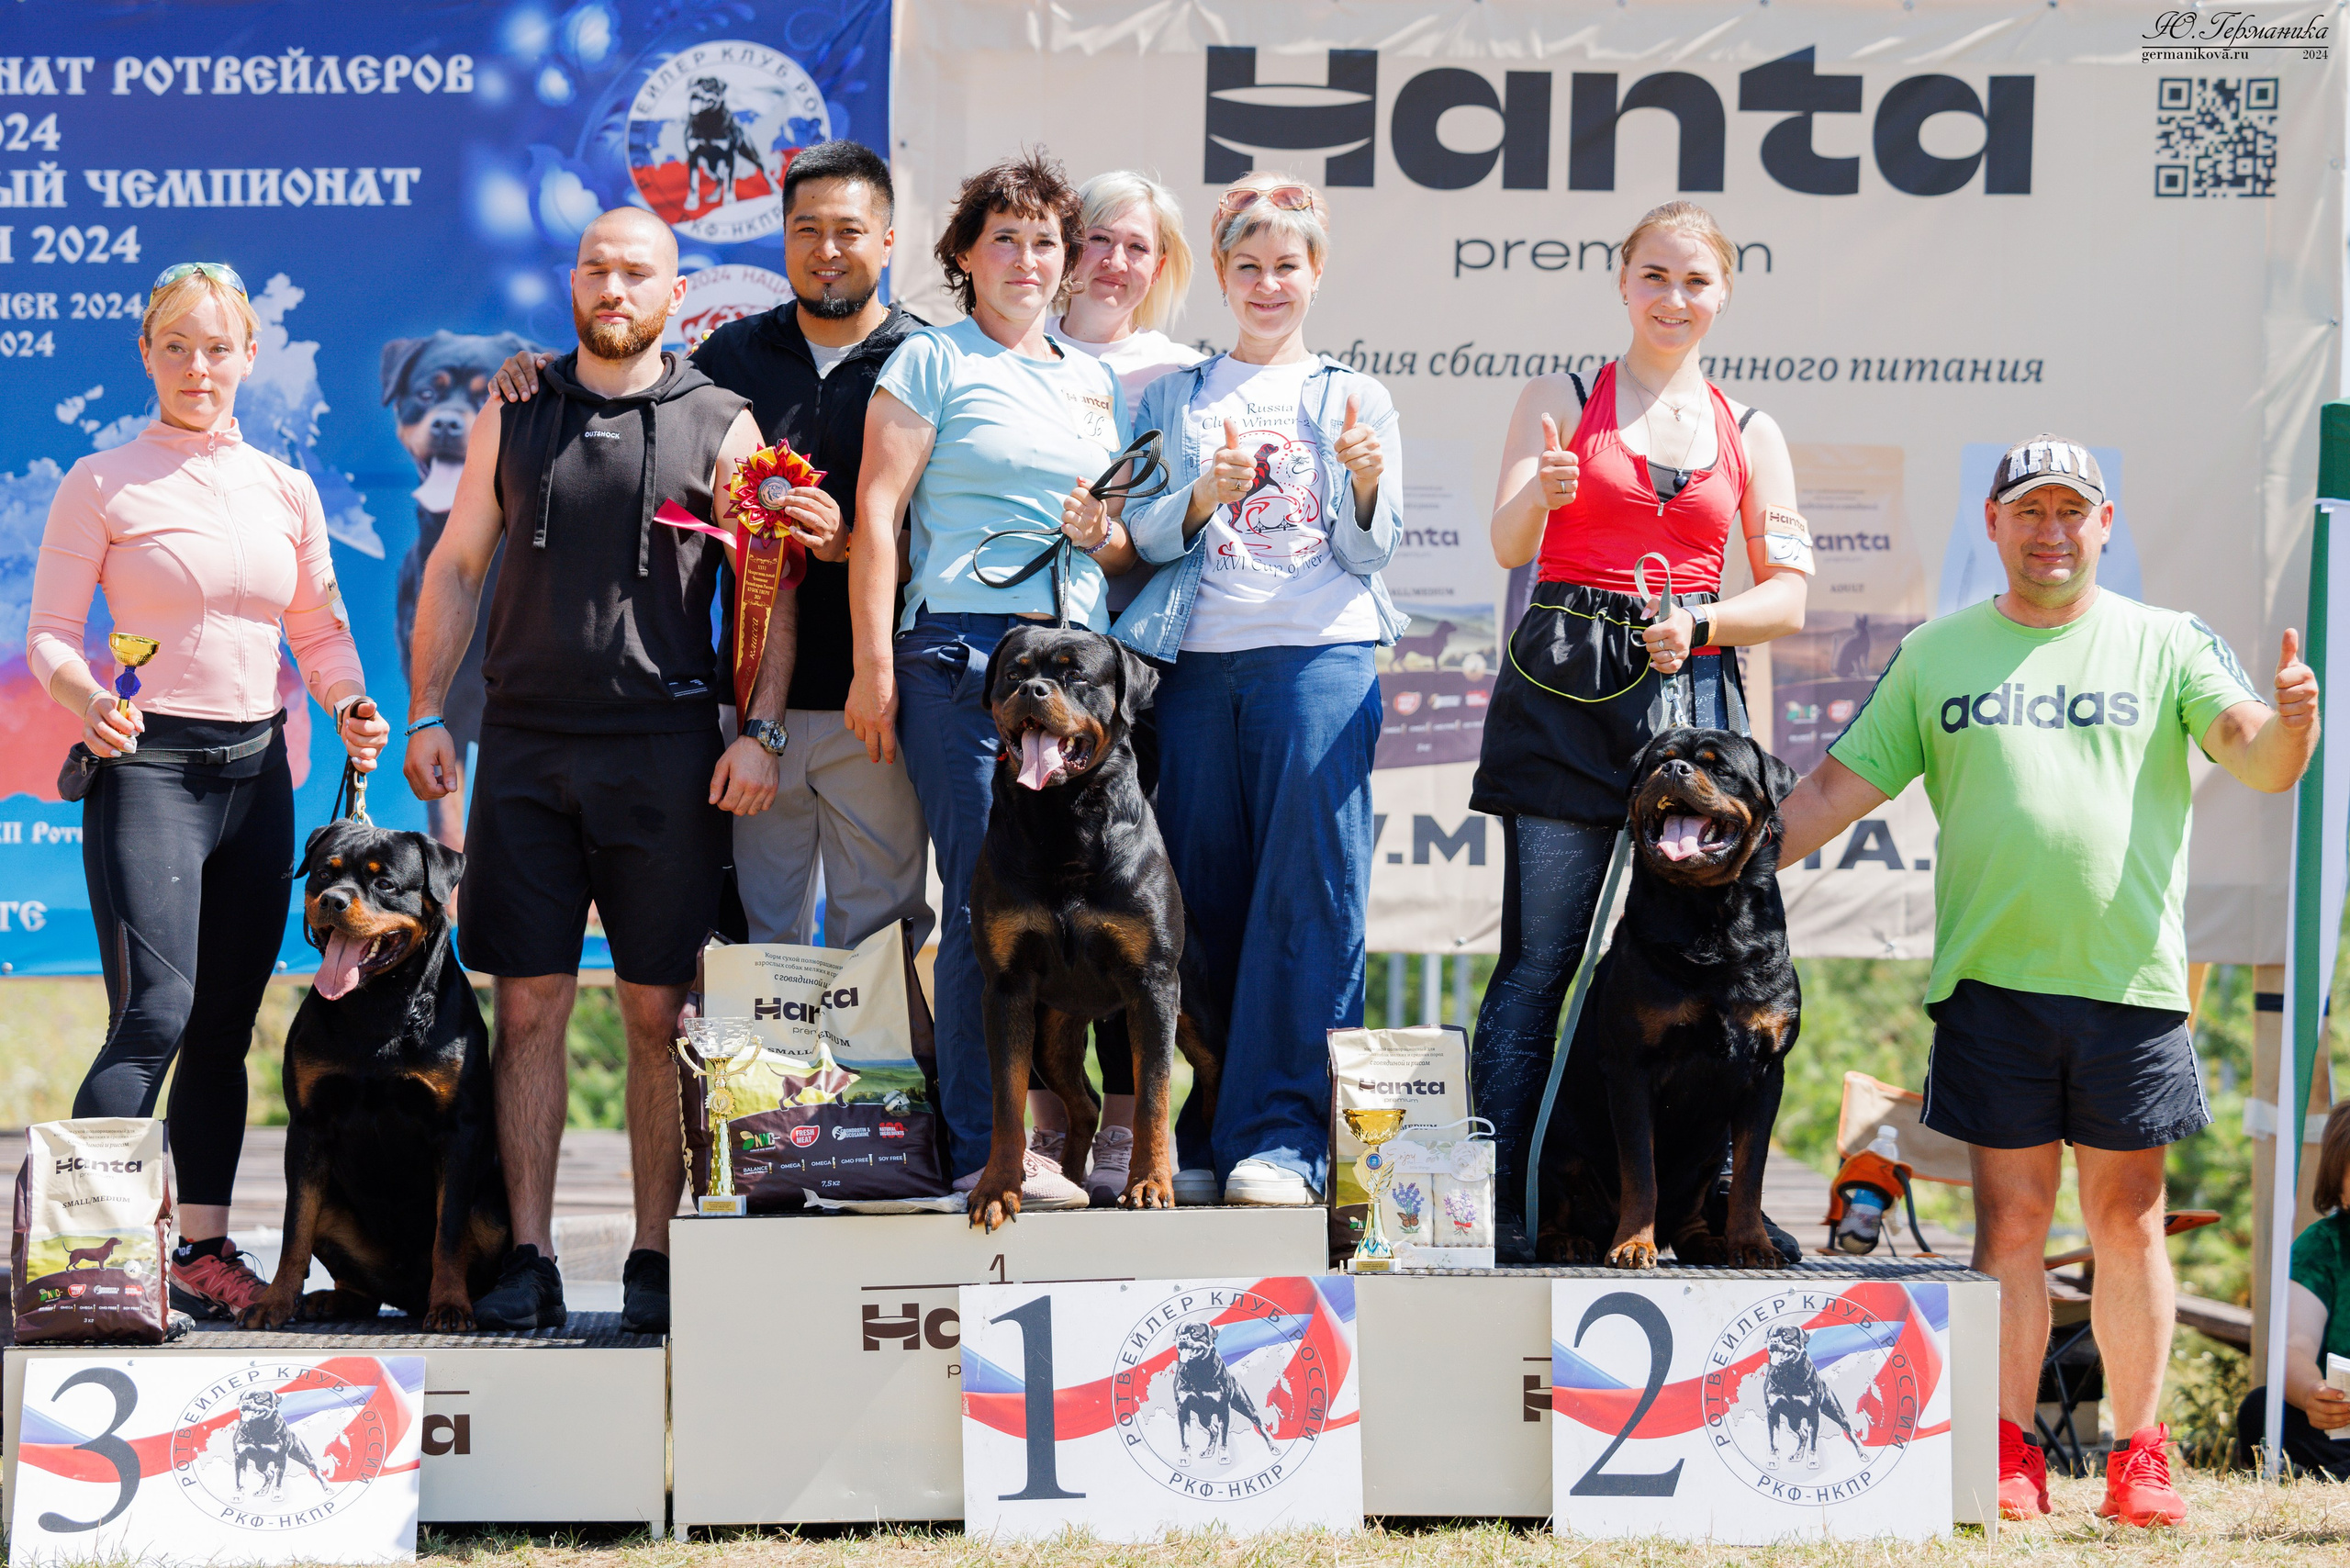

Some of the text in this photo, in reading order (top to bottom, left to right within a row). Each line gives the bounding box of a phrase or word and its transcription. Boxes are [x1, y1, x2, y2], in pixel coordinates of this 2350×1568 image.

[111, 47, 475, 96] РОТВЕЙЛЕРОВ
[722, 48, 788, 78] КЛУБ
[0, 112, 62, 151] 24
[1204, 44, 2035, 196] Hanta
[83, 167, 421, 207] ЧЕМПИОНАТ
[31, 225, 142, 264] 2024
[1455, 238, 1773, 278] premm
[70, 292, 144, 319] 2024
[1850, 356, 2044, 383] питания
[1247, 402, 1293, 415] Russia
[584, 431, 621, 440] OUTSHOCK
[1770, 511, 1806, 533] Hanta
[1811, 532, 1891, 551] anta
[1213, 555, 1246, 572] XXVI
[1251, 558, 1283, 577] Cup
[1288, 557, 1302, 578] of
[749, 617, 759, 659] класса
[1940, 682, 2140, 734] adidas
[755, 960, 785, 969] взрослых
[804, 966, 826, 974] мелких
[779, 974, 823, 987] говядиной
[1359, 1078, 1446, 1095] Hanta
[795, 1128, 815, 1137] FRESH
[796, 1136, 812, 1144] MEAT
[62, 1194, 130, 1209] SMALL/MEDIUM
[1114, 1290, 1326, 1448] РОТВЕЙЛЕР КЛУБ РОССИИ
[1706, 1294, 1916, 1450] РОТВЕЙЛЕР КЛУБ РОССИИ
[989, 1294, 1087, 1501] 1
[1569, 1291, 1685, 1497] 2
[175, 1366, 384, 1488] РОТВЕЙЛЕР КЛУБ РОССИИ
[38, 1366, 141, 1533] 3
[1169, 1463, 1285, 1499] РКФ-НКПР
[1757, 1469, 1874, 1504] РКФ-НКПР
[220, 1500, 336, 1528] РКФ-НКПР
